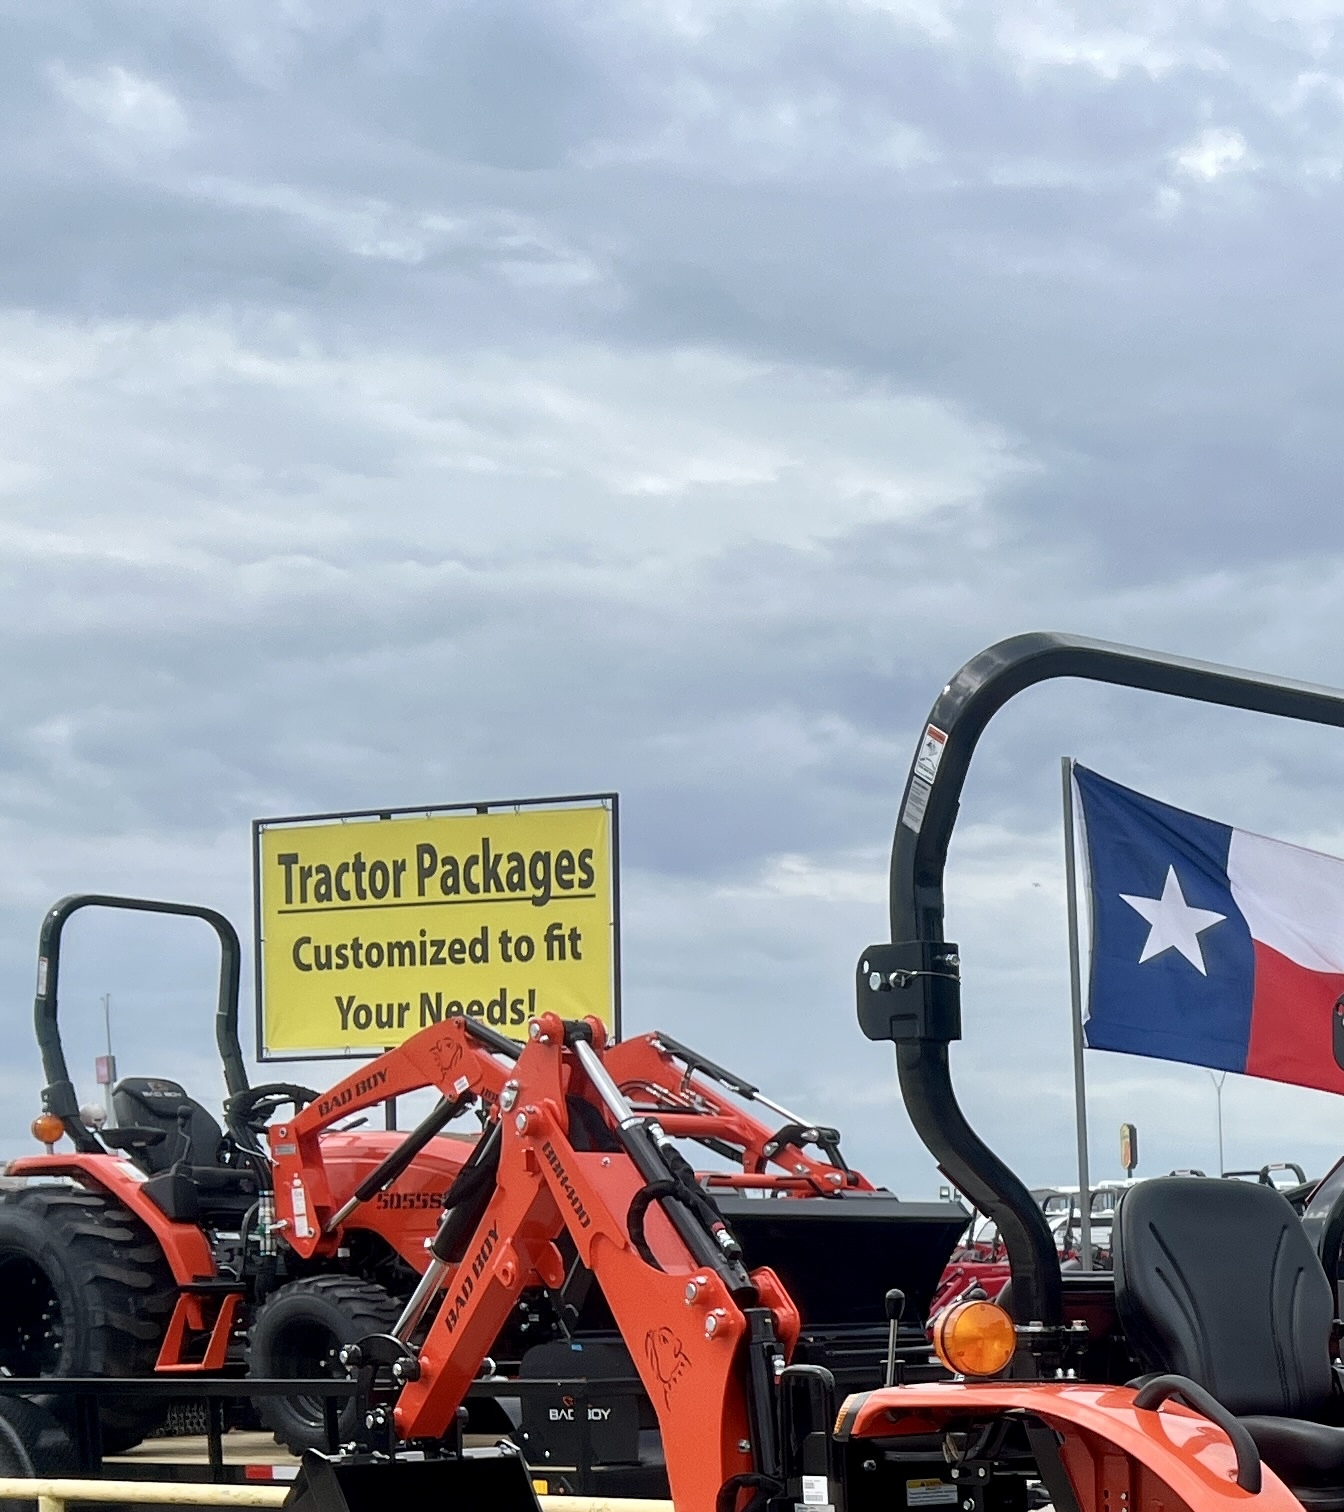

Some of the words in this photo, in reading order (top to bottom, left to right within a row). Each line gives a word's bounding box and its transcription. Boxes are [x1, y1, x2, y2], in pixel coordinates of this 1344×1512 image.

[277, 852, 406, 905] Tractor
[416, 837, 595, 907] Packages
[292, 926, 489, 972] Customized
[498, 930, 535, 963] to
[544, 923, 582, 962] fit
[335, 995, 410, 1032] Your
[420, 987, 536, 1028] Needs!
[318, 1090, 353, 1118] BAD
[444, 1275, 474, 1335] BAD
[472, 1219, 499, 1280] BOY
